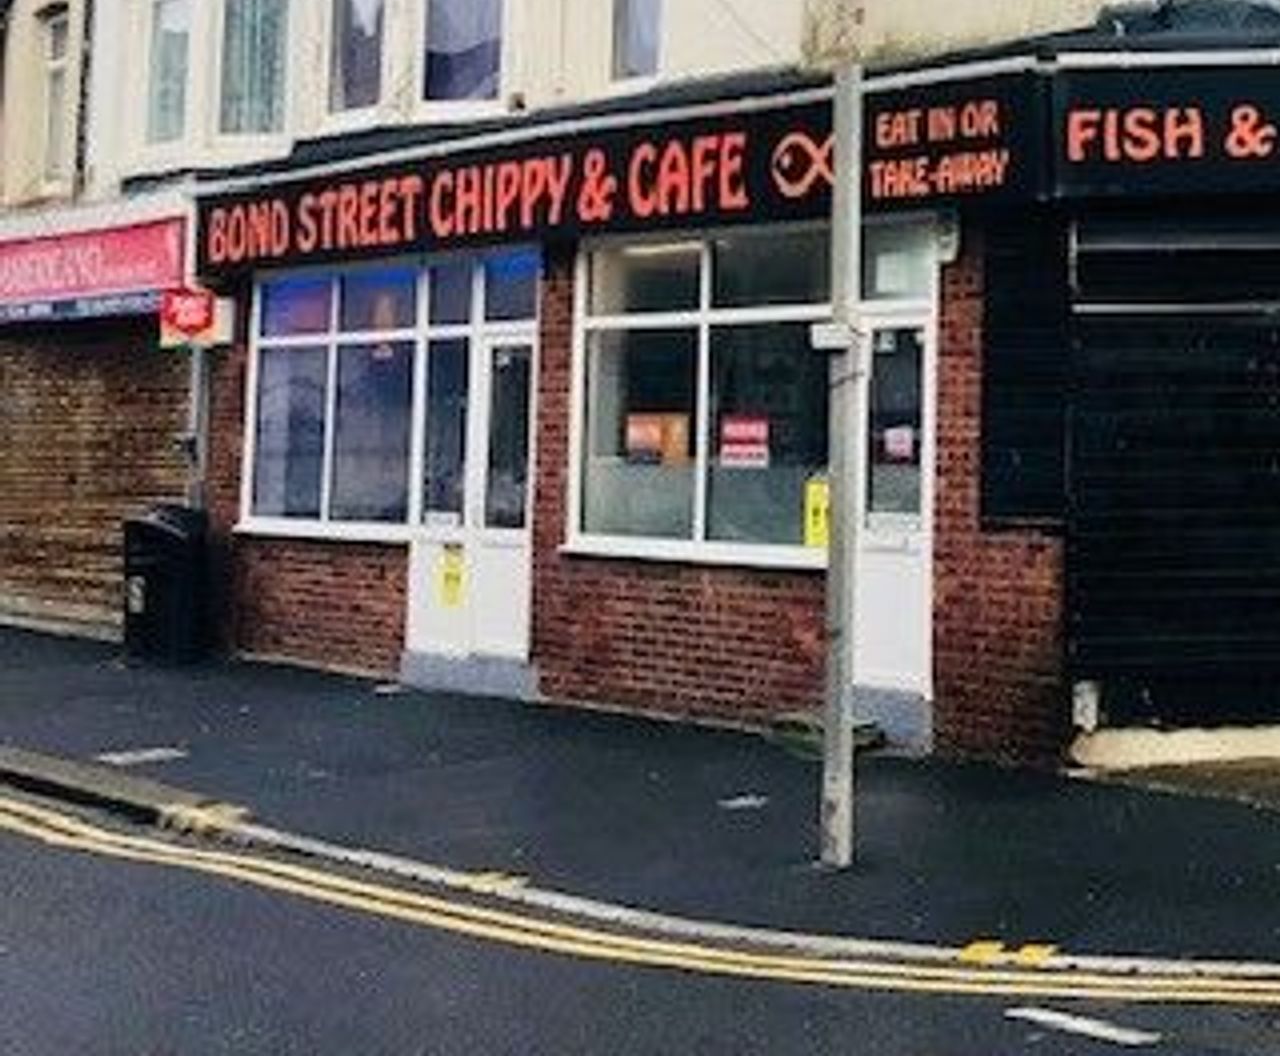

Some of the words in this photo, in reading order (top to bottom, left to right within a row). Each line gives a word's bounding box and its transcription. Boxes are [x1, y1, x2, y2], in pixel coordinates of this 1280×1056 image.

[876, 109, 921, 147] EAT
[928, 107, 956, 141] IN
[960, 100, 999, 137] OR
[1066, 105, 1202, 161] FISH
[1224, 104, 1278, 158] &
[208, 199, 291, 263] BOND
[296, 175, 424, 253] STREET
[429, 154, 573, 237] CHIPPY
[577, 148, 617, 222] &
[628, 133, 750, 216] CAFE
[869, 149, 1010, 198] TAKE-AWAY
